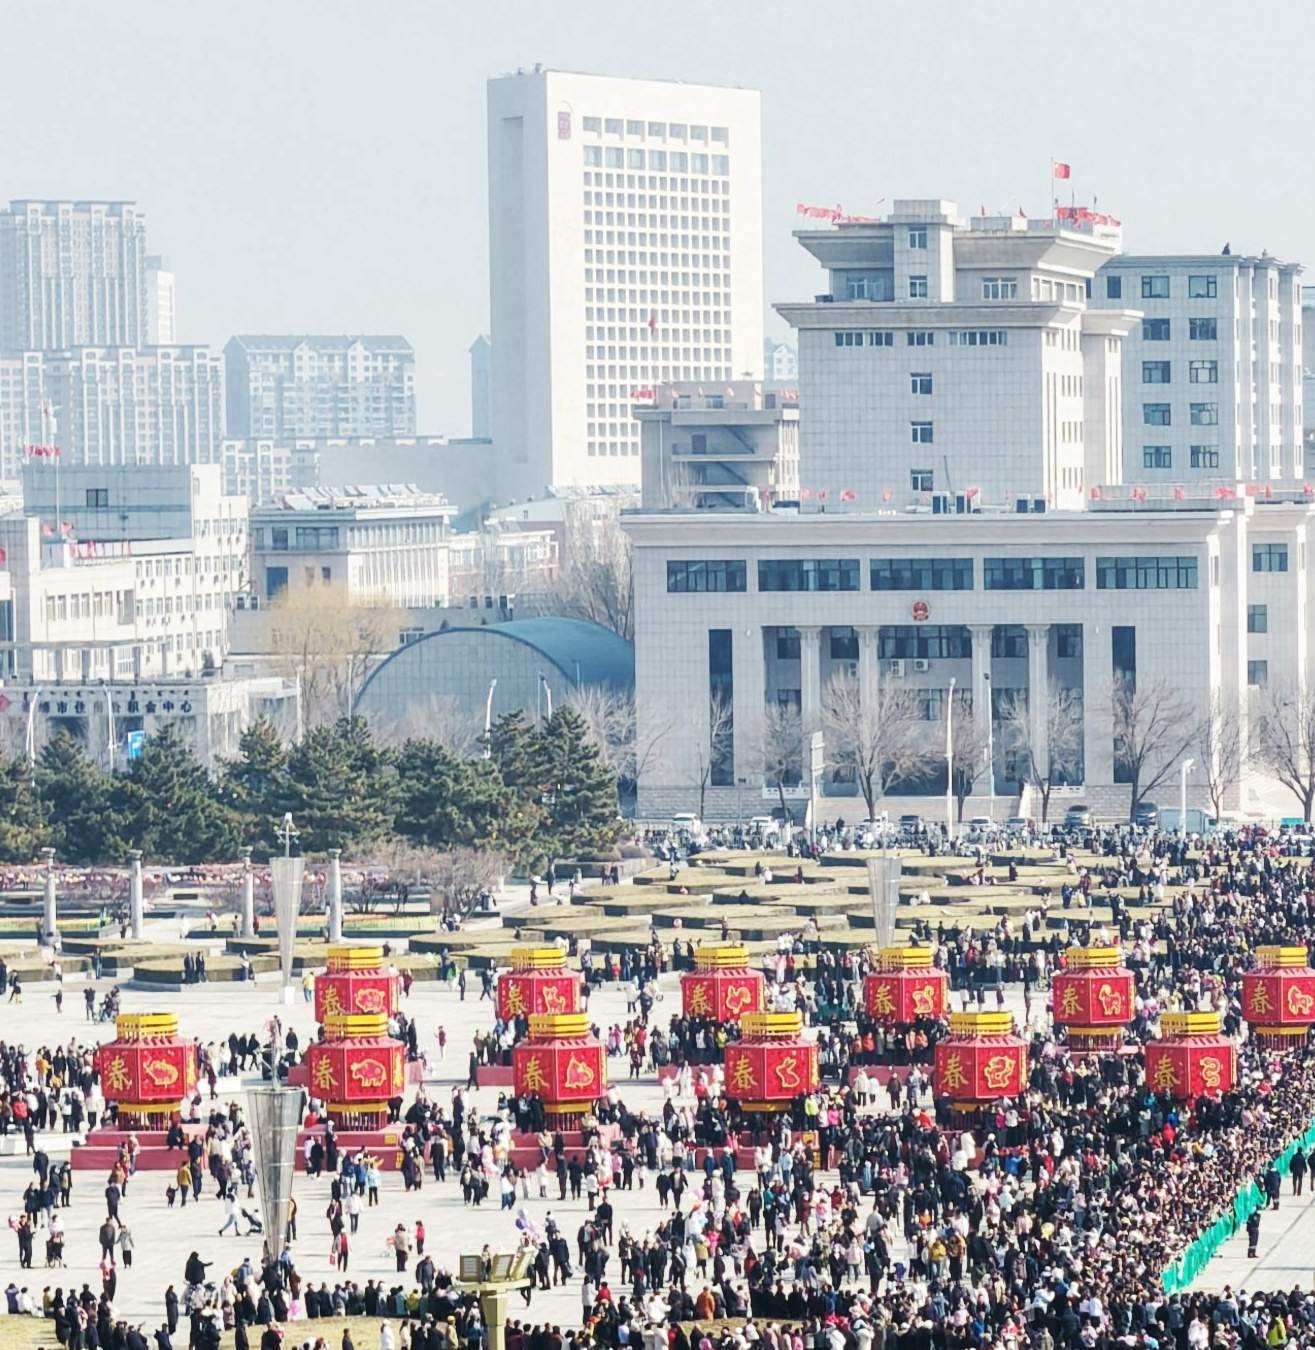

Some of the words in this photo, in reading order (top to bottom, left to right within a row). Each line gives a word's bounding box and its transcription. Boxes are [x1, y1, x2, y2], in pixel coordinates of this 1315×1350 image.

[321, 985, 346, 1014] 春
[503, 984, 528, 1014] 春
[689, 984, 713, 1014] 春
[874, 985, 897, 1014] 春
[1061, 984, 1084, 1014] 春
[1249, 984, 1274, 1014] 春
[106, 1056, 133, 1091] 春
[314, 1055, 338, 1090] 春
[523, 1055, 550, 1090] 春
[732, 1054, 758, 1090] 春
[941, 1054, 968, 1089] 春
[1154, 1058, 1180, 1089] 春
